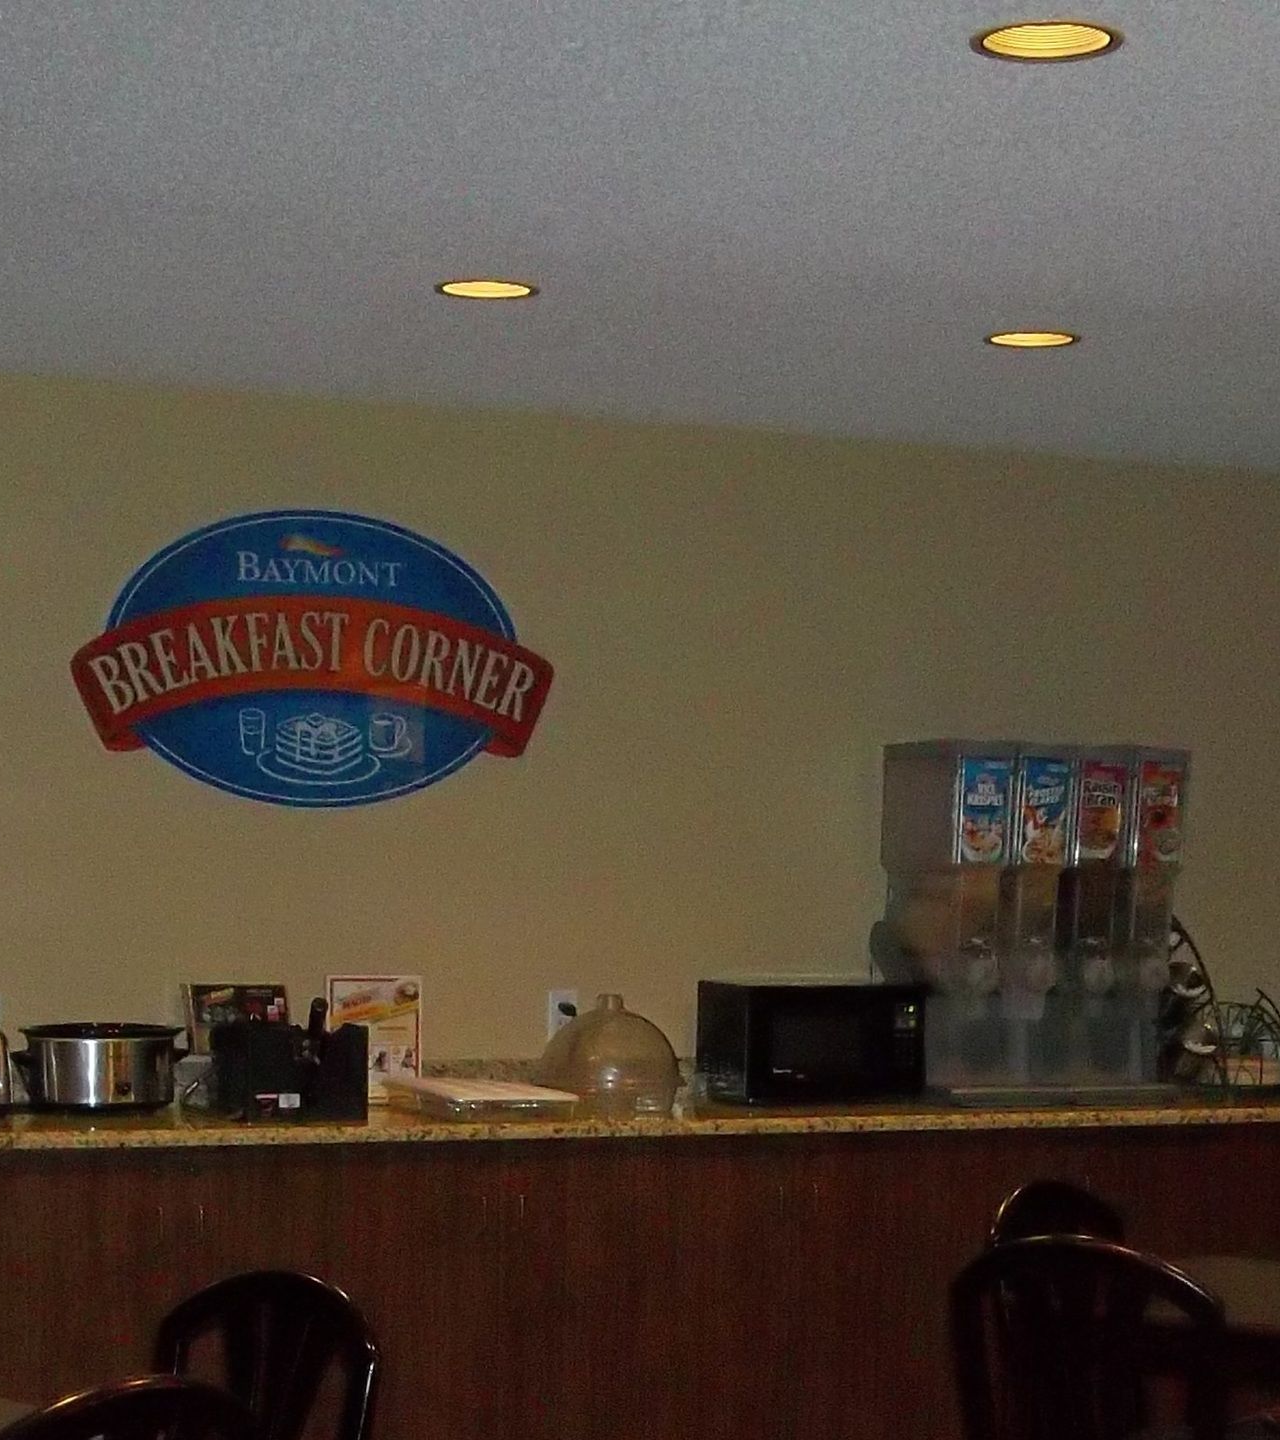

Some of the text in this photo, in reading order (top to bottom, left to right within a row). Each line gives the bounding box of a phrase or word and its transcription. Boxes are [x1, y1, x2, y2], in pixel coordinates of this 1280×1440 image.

[236, 550, 402, 587] BAYMONT
[87, 610, 536, 722] BREAKFAST CORNER
